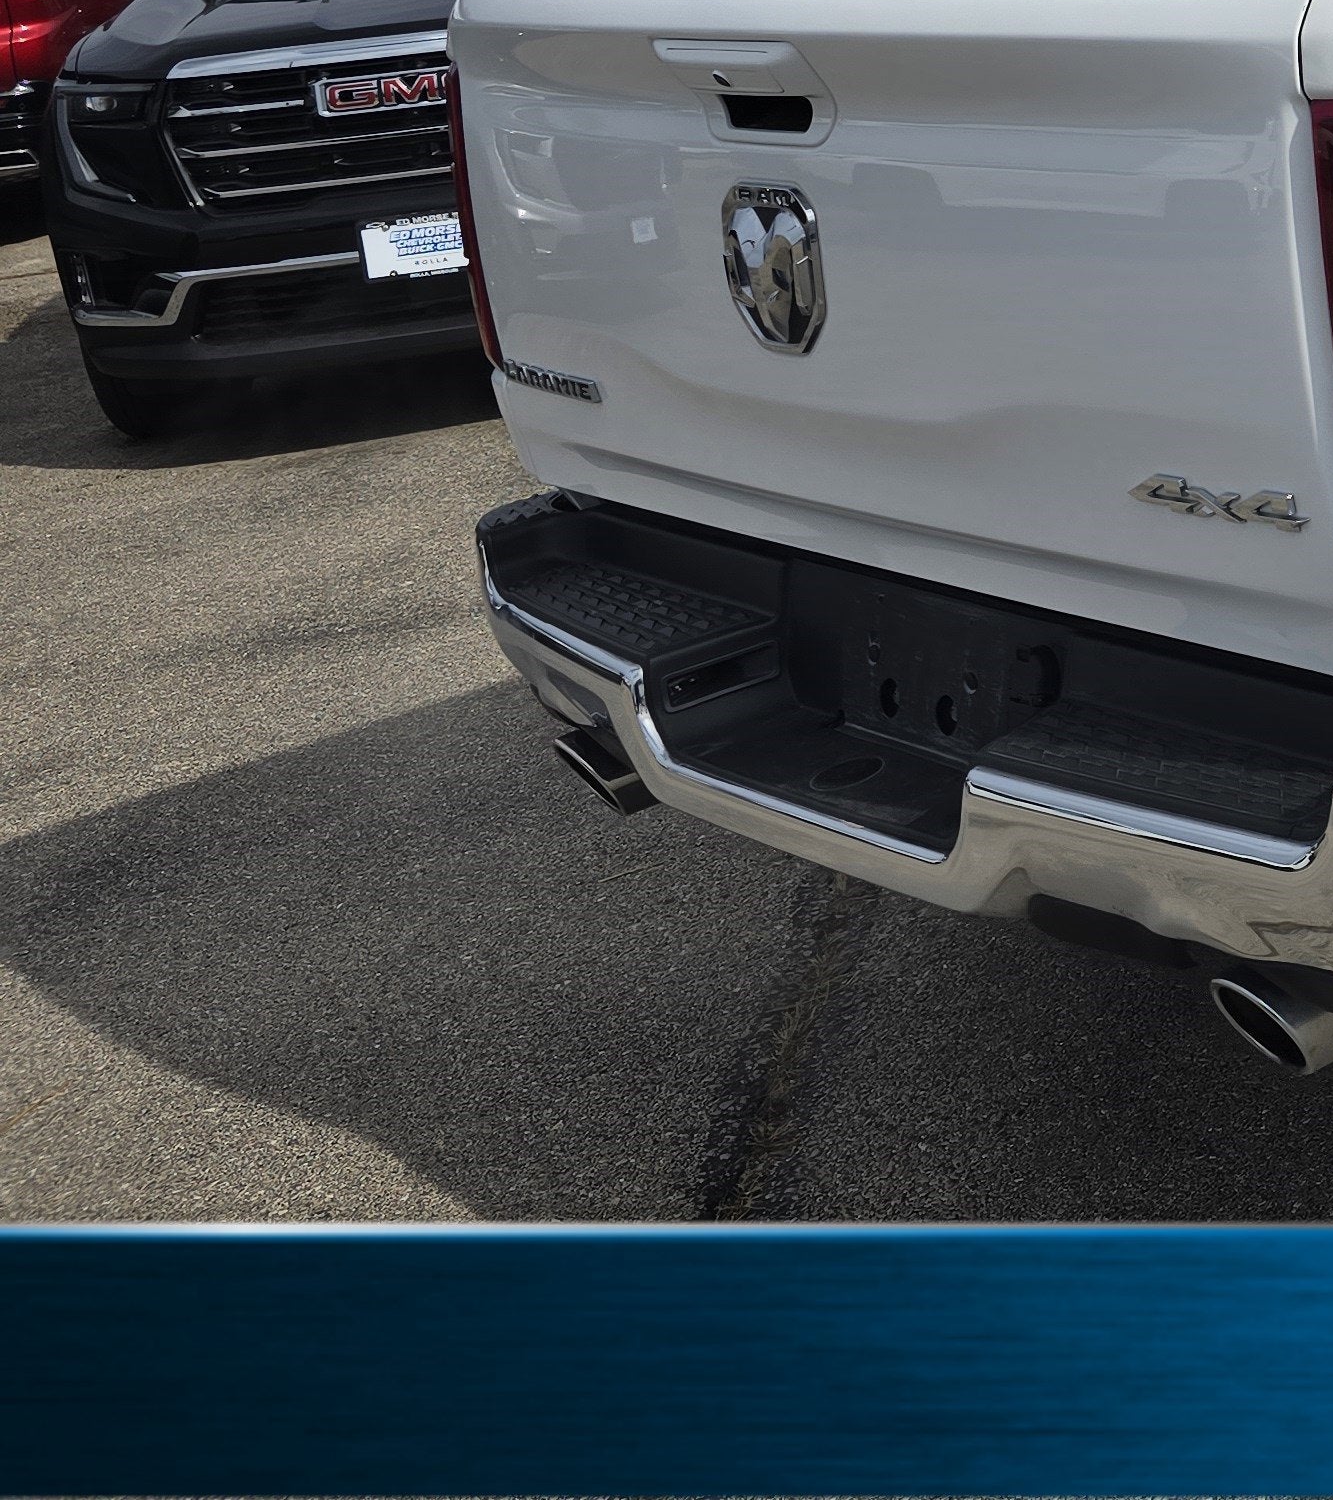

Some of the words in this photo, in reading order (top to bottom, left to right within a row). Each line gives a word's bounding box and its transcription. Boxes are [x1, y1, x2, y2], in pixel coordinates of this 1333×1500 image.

[326, 71, 447, 111] GM
[734, 187, 798, 207] RAM
[390, 229, 410, 243] ED
[503, 360, 597, 402] LARAMIE
